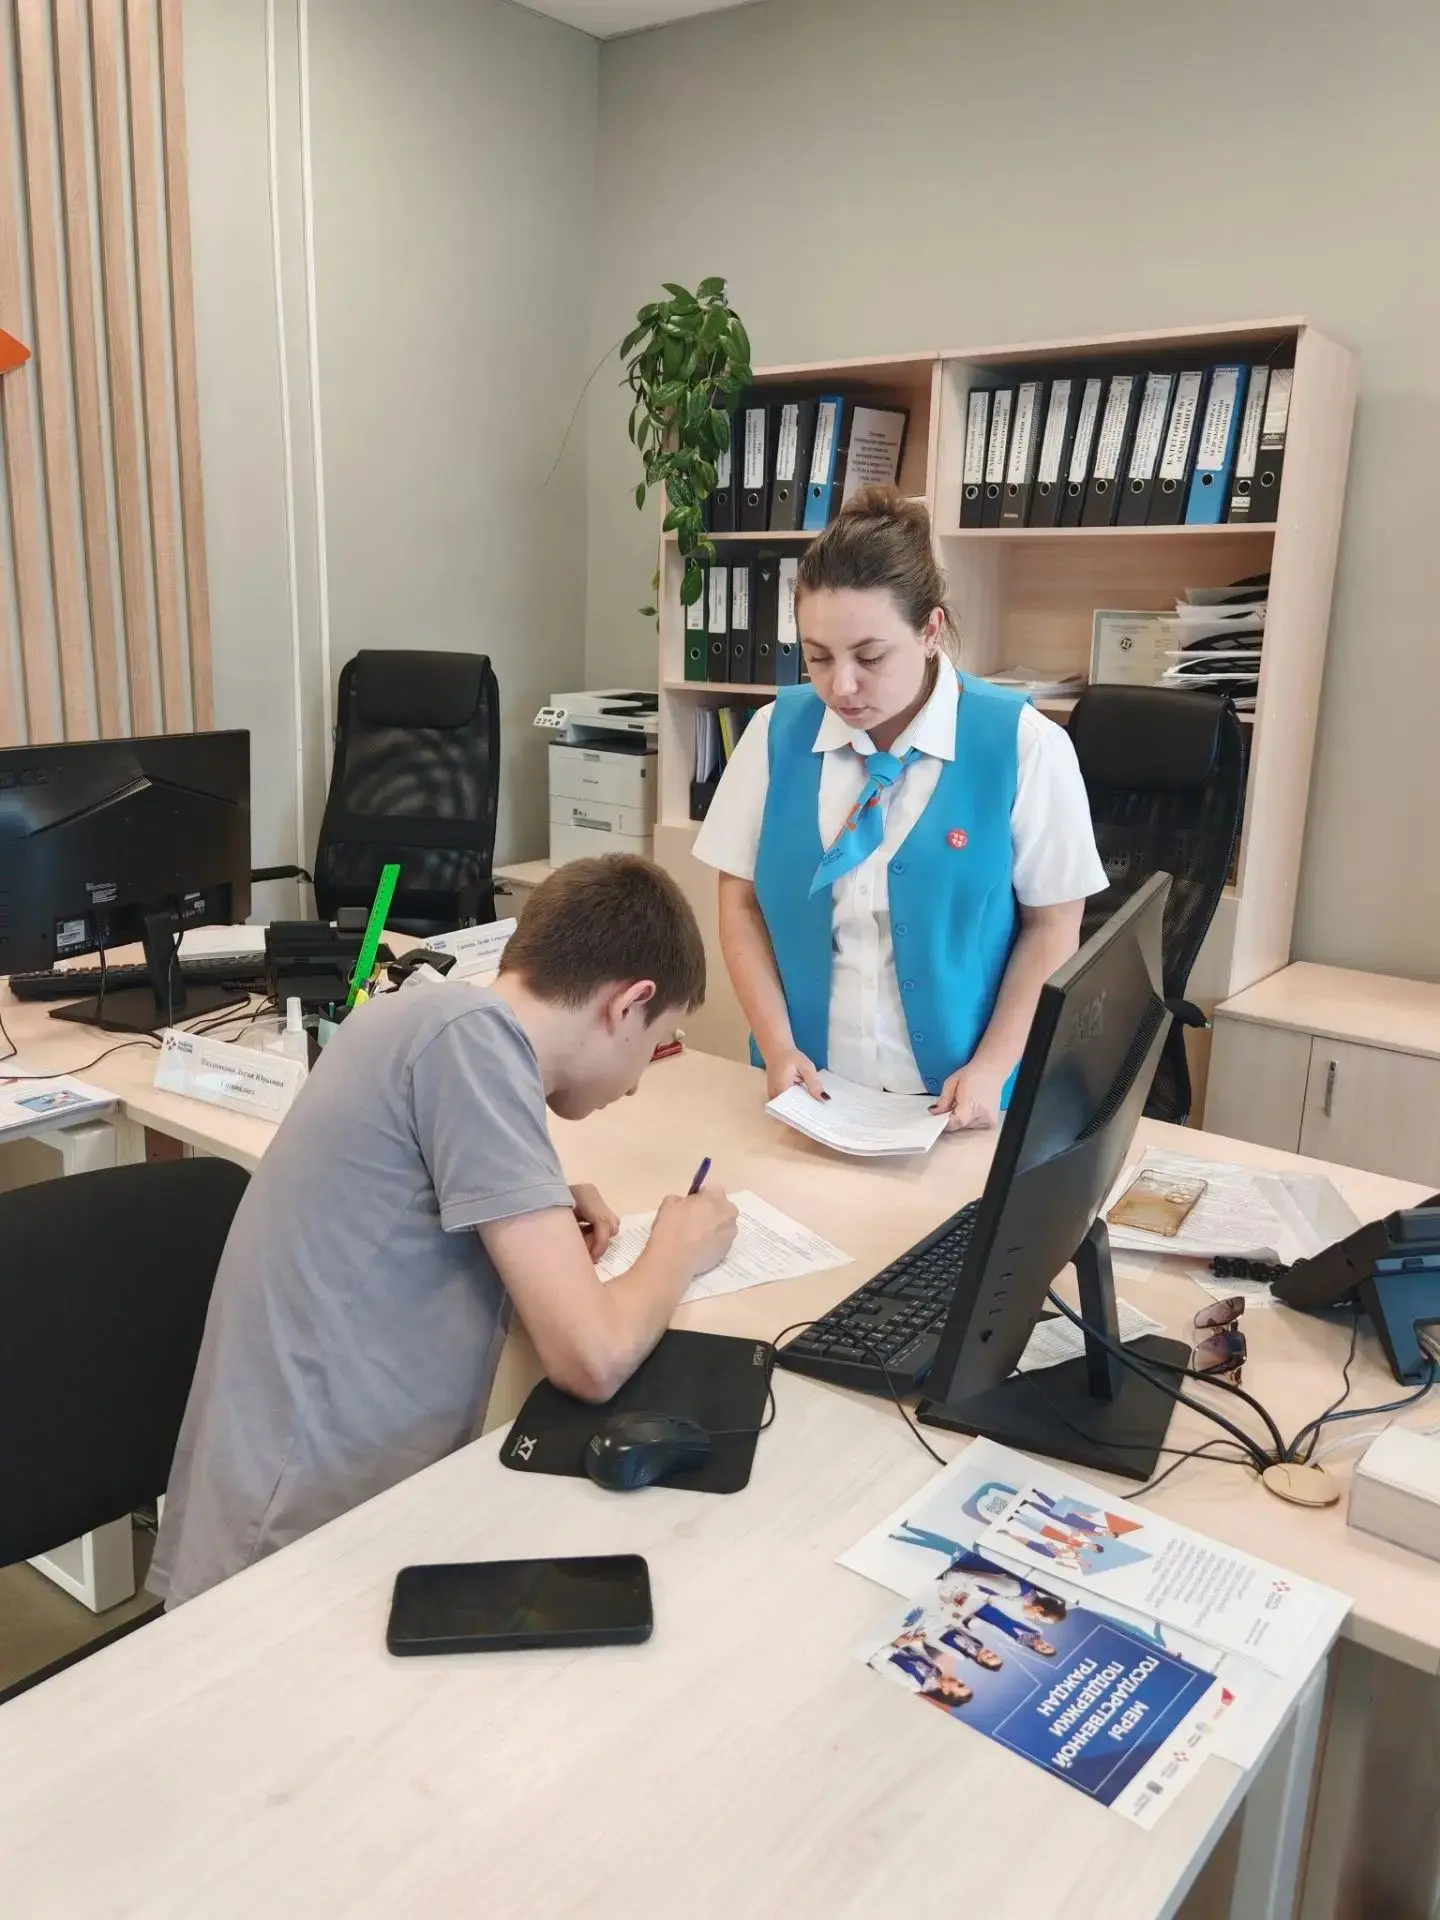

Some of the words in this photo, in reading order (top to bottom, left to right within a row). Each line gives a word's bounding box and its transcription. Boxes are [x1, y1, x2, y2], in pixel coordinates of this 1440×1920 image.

[1036, 1656, 1097, 1717] ГРАЖДАН
[1048, 1660, 1124, 1737] ПОДДЕРЖКИ
[1051, 1654, 1159, 1770] ГОСУДАРСТВЕННОЙ
[1107, 1700, 1149, 1742] МЕРЫ
